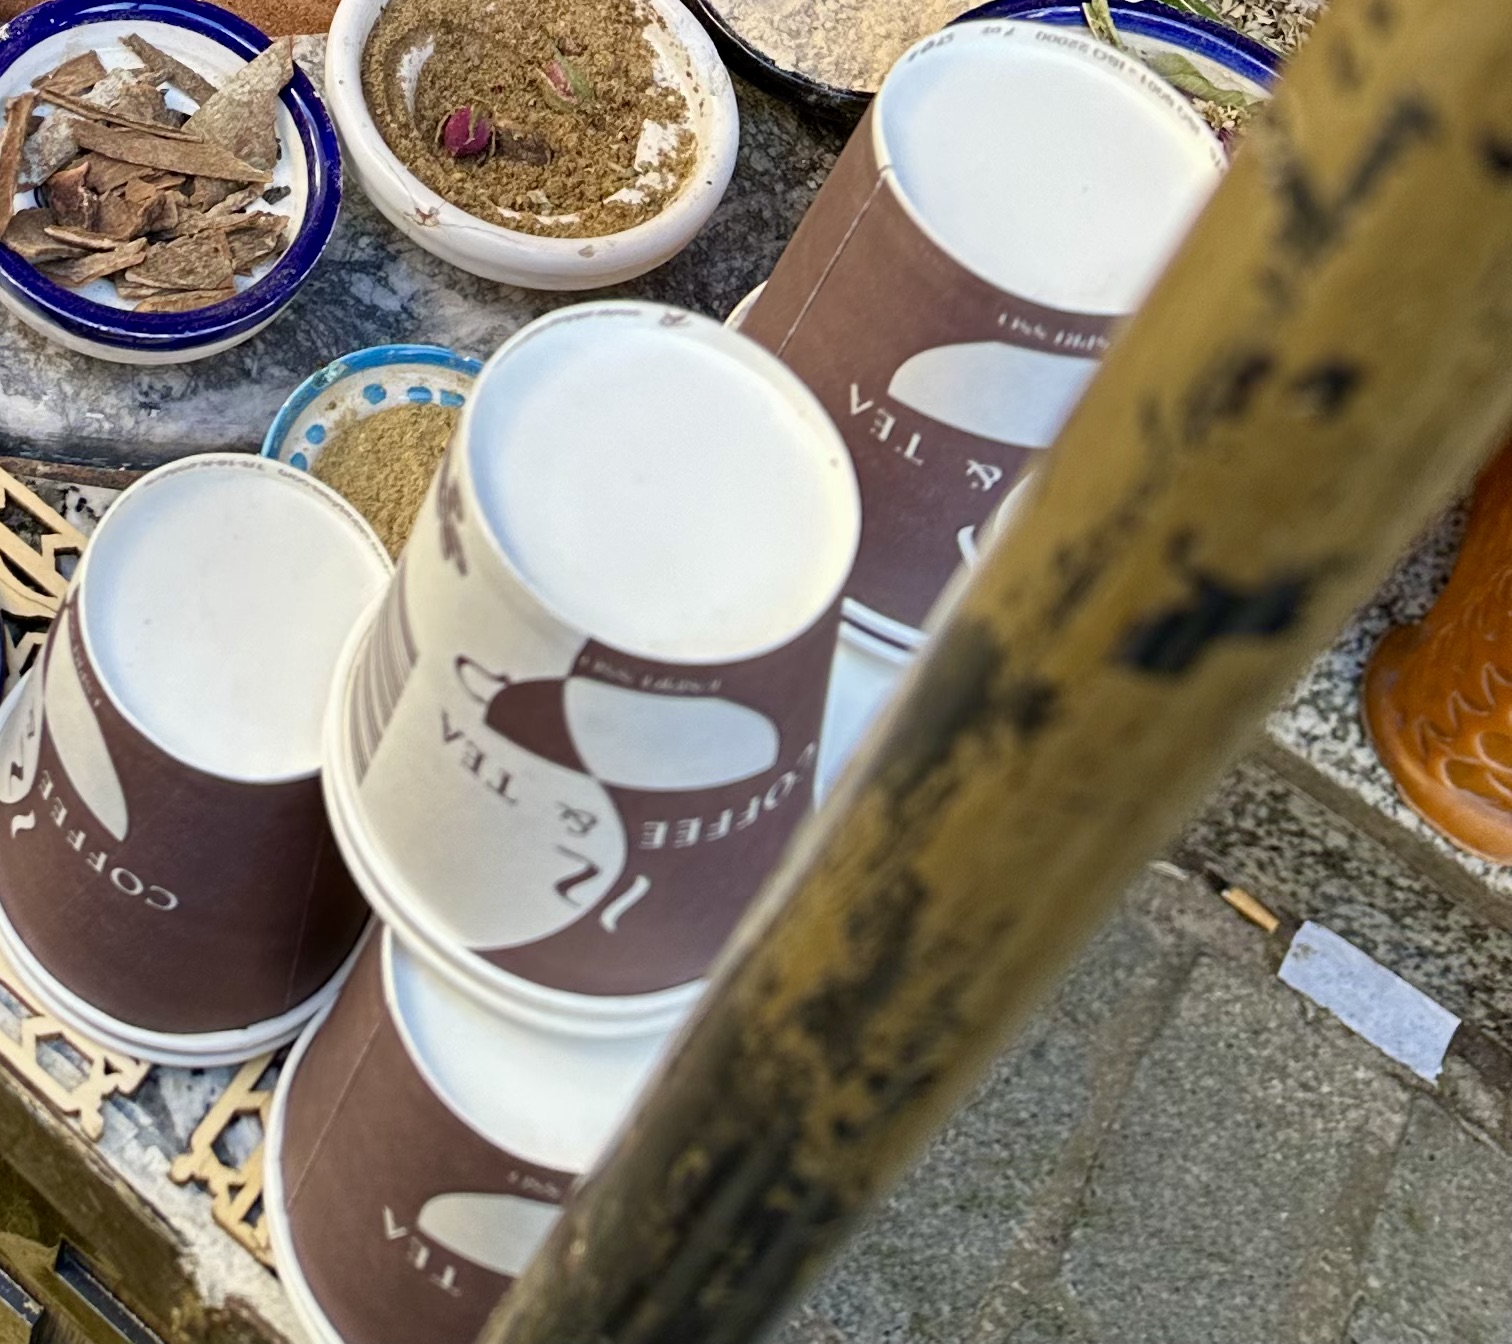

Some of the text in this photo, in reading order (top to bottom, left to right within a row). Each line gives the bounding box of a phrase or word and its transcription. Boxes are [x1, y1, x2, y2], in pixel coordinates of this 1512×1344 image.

[849, 382, 925, 467] TEA
[441, 708, 518, 805] TEA
[639, 741, 818, 850] COFFEE
[37, 769, 180, 912] COFFEE
[381, 1204, 464, 1298] TEA
